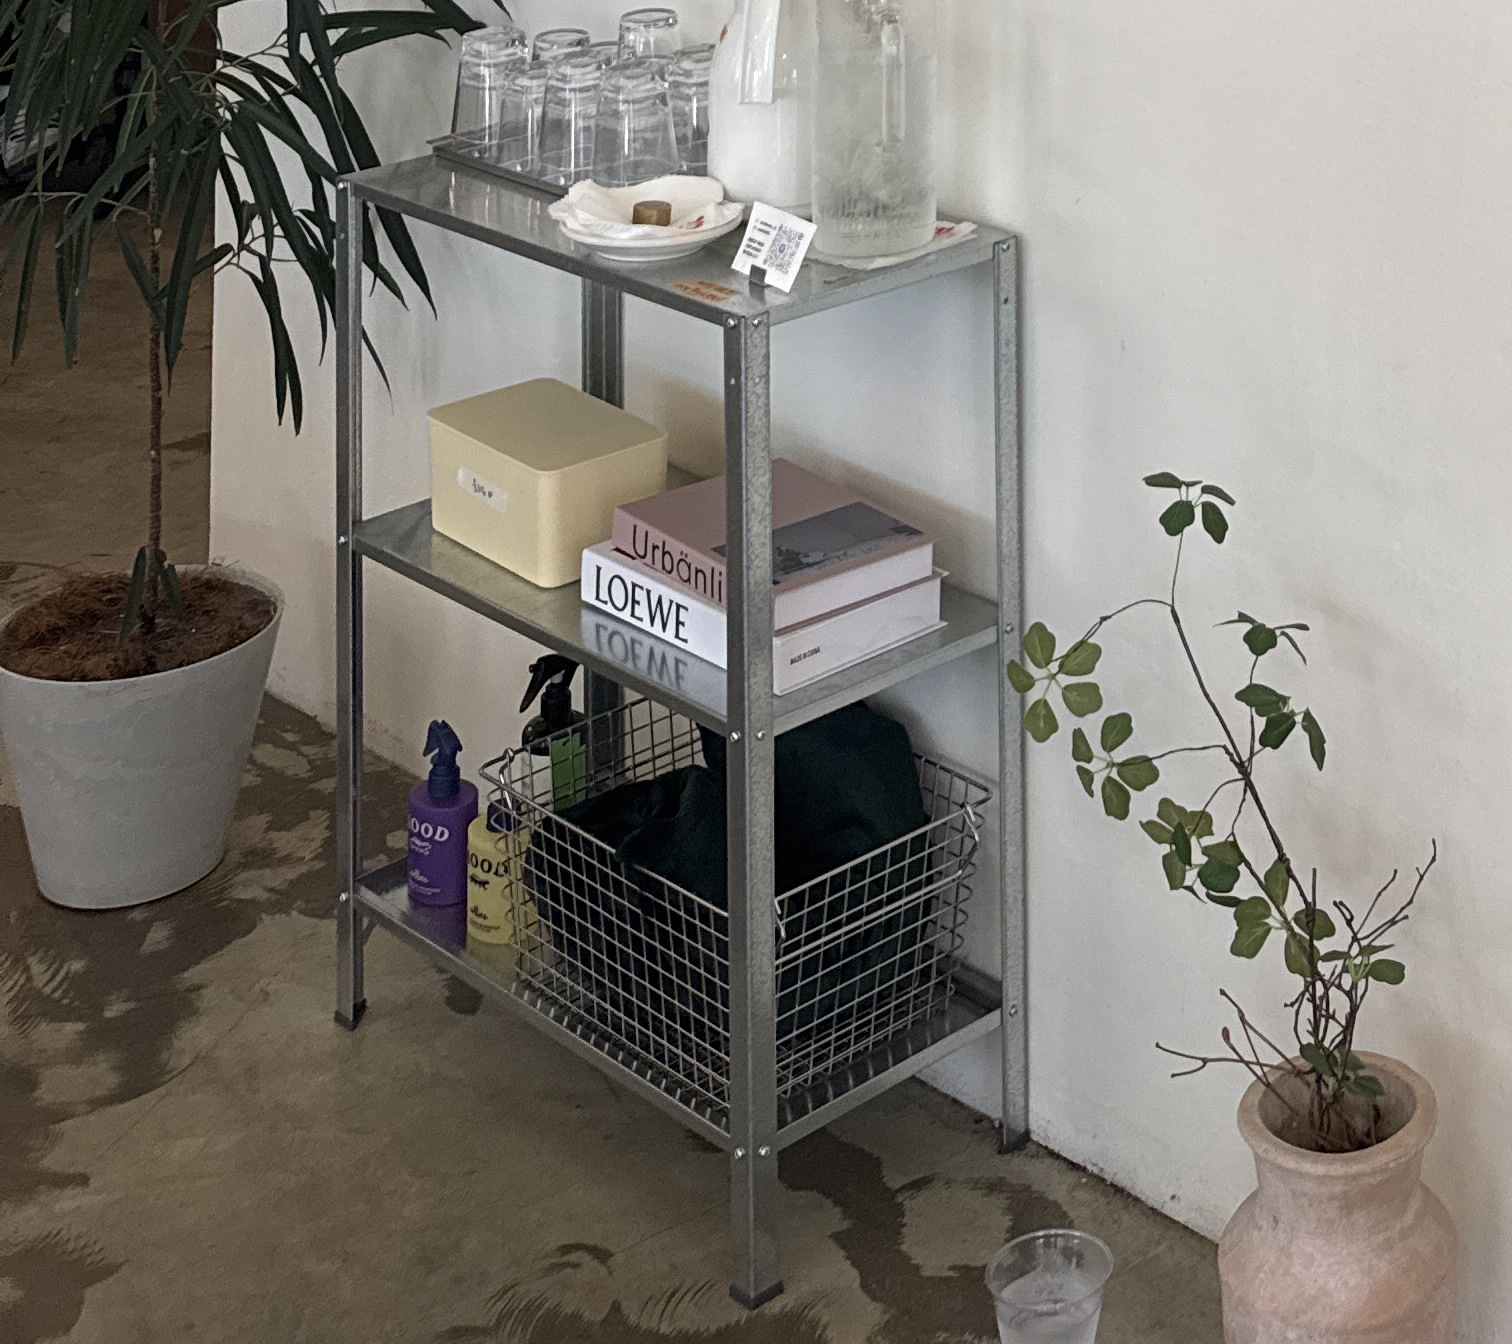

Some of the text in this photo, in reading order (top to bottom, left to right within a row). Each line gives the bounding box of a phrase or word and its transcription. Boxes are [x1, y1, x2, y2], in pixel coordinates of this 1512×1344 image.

[593, 564, 689, 644] LOEWE
[409, 817, 450, 842] OOD
[469, 852, 511, 878] OOD
